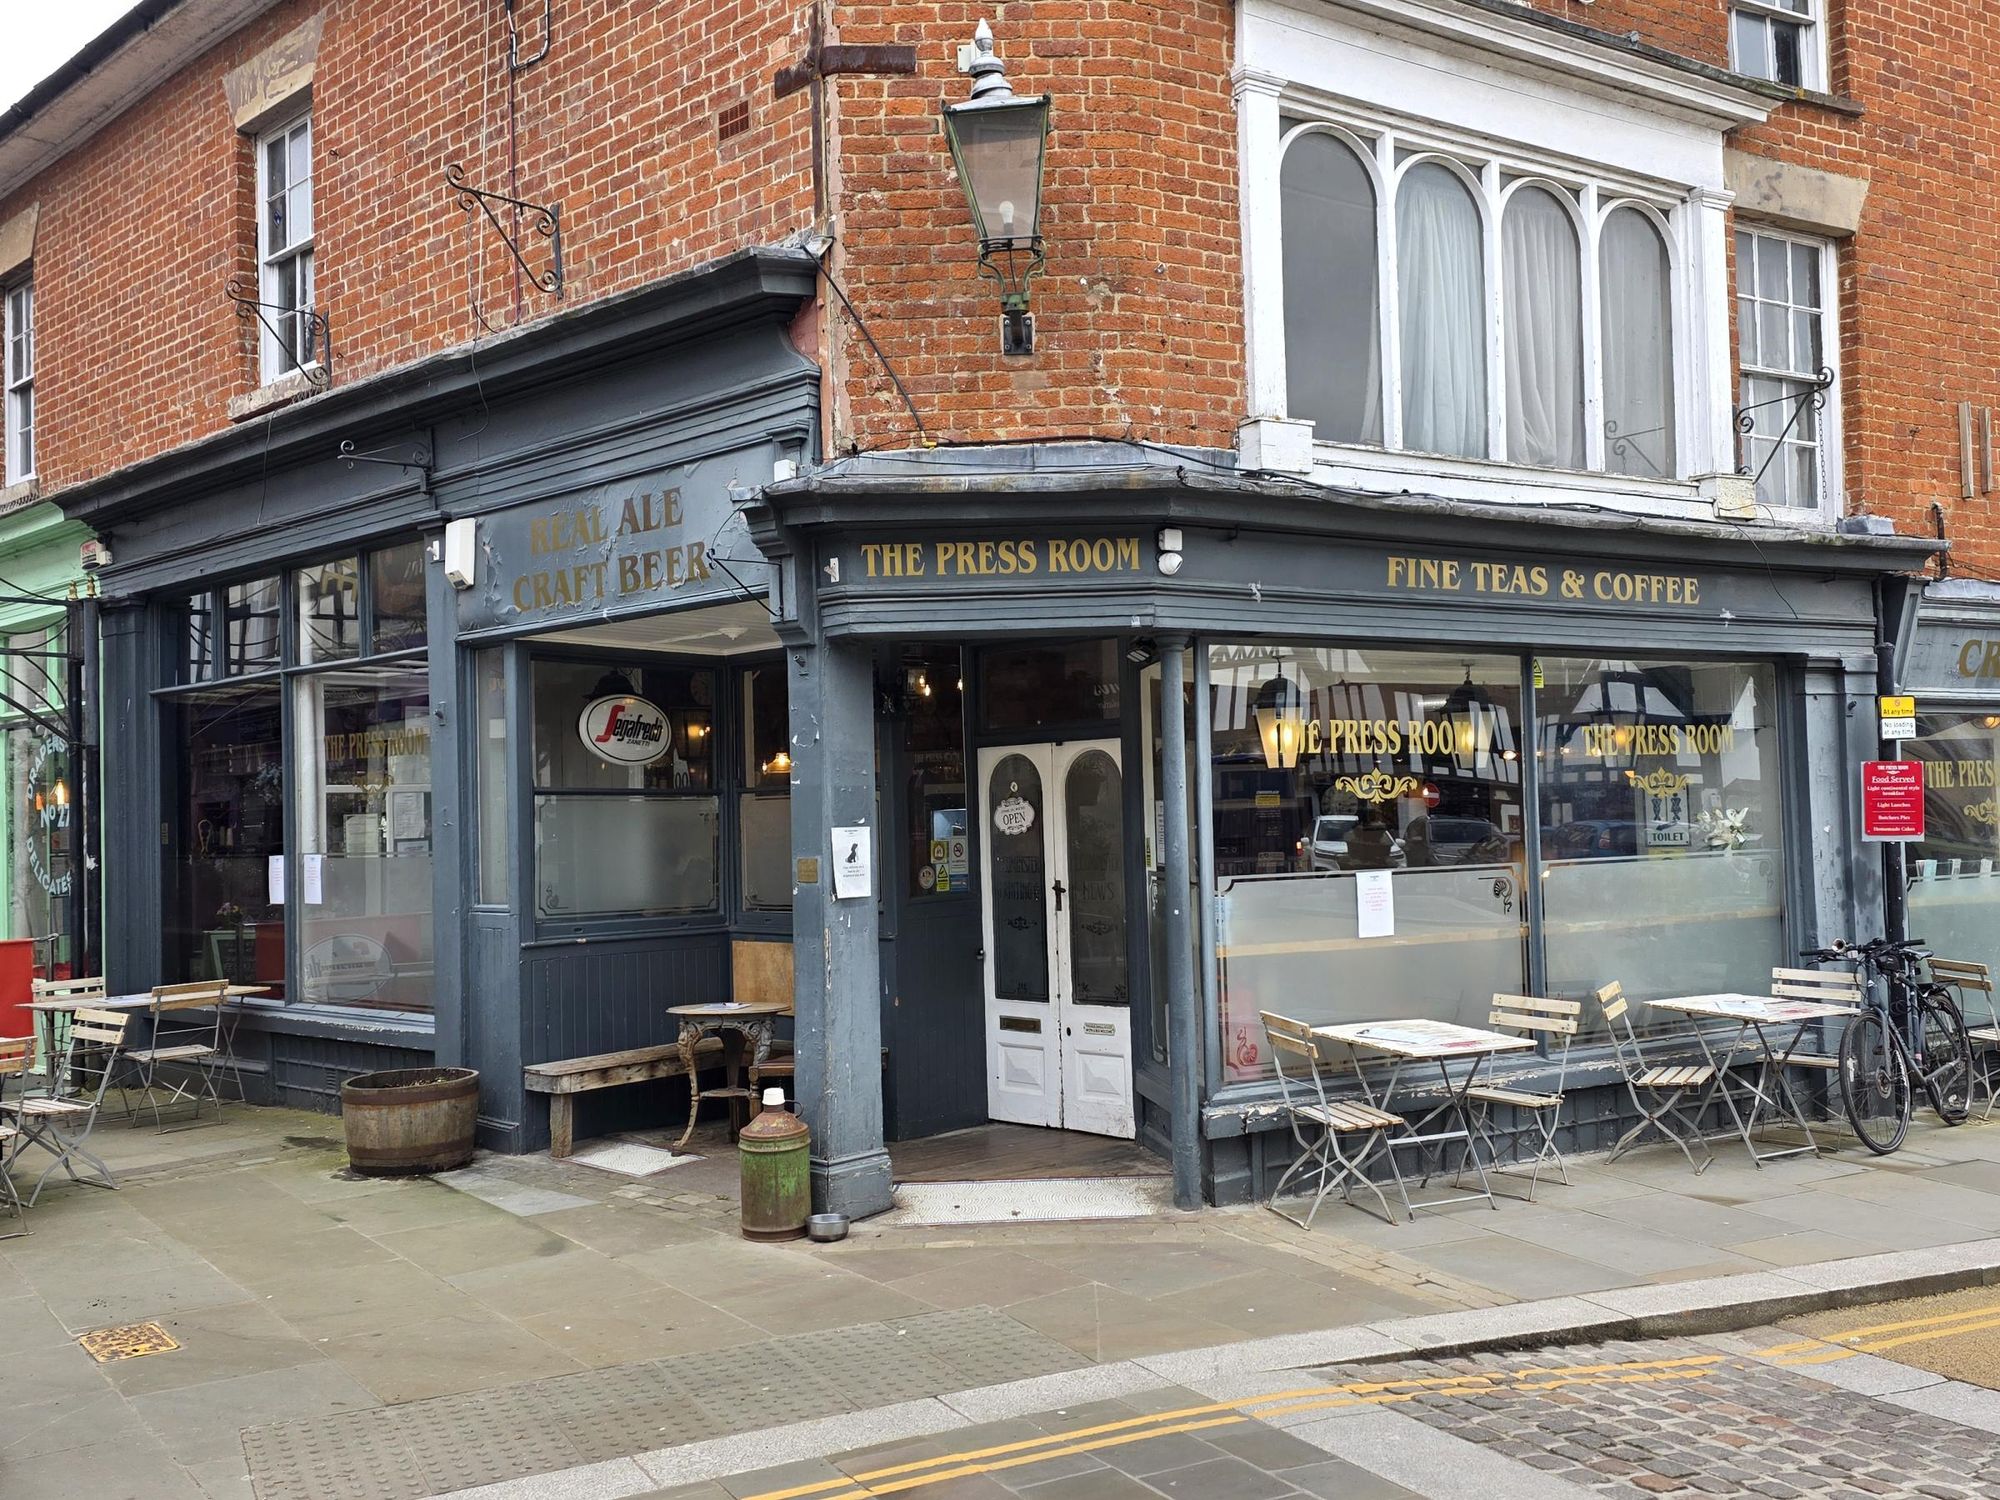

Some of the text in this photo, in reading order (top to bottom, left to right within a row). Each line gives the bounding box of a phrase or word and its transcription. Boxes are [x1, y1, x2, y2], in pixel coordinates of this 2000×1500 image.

[530, 486, 684, 556] REAL ALE
[860, 537, 1141, 577] THE PRESS ROOM
[512, 540, 711, 613] CRAFT BEER
[1386, 557, 1700, 605] FINE TEAS & COFFEE
[595, 704, 664, 742] Segafredo
[1330, 719, 1401, 755] PRESS
[1581, 723, 1734, 756] THE PRESS ROOM
[1894, 721, 1913, 729] loading
[324, 726, 424, 762] THE PRESS ROOM
[626, 739, 651, 747] ZANETTI
[1925, 760, 1954, 789] THE
[1002, 811, 1027, 826] OPEN
[1652, 832, 1684, 842] TOILET
